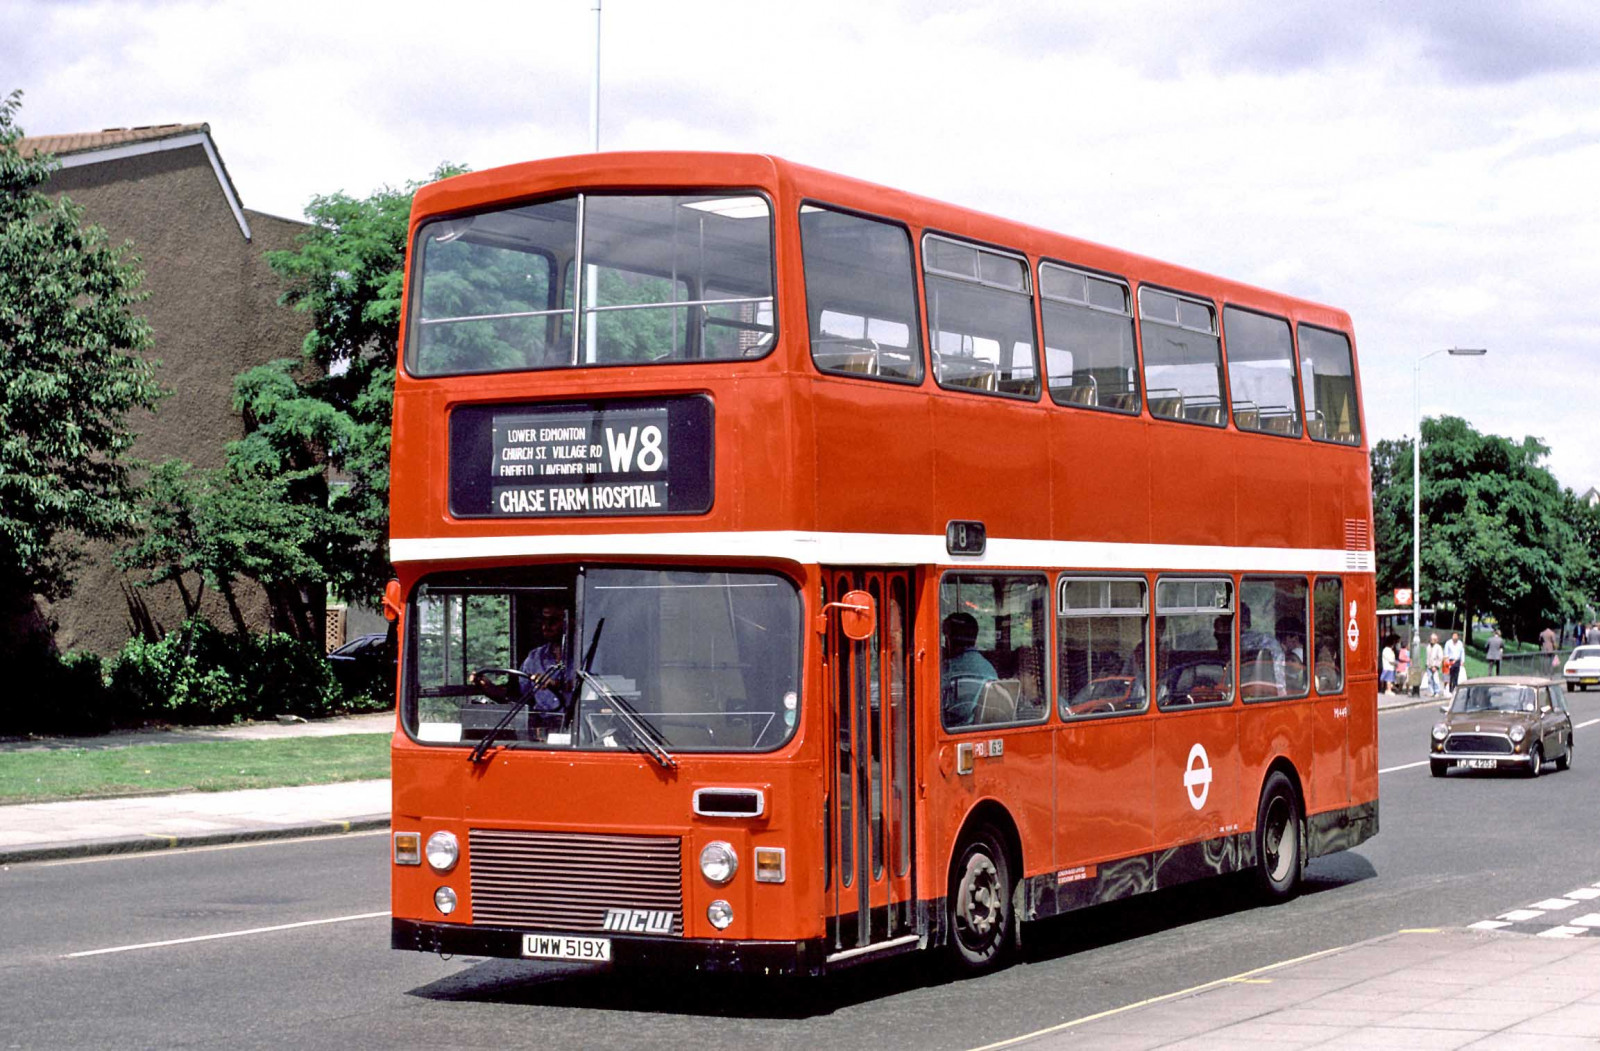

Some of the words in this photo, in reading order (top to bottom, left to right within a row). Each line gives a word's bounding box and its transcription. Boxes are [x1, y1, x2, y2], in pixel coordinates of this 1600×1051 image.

[507, 429, 537, 443] LOWER
[539, 427, 586, 442] EDMONTON
[502, 446, 533, 461] CHURCH
[552, 445, 587, 459] VILLAGE
[589, 444, 603, 458] RD
[605, 425, 664, 473] W8
[499, 489, 546, 513] CHASE
[549, 487, 590, 511] FARM
[592, 484, 662, 509] HOSPITAL
[991, 740, 1002, 754] 63
[528, 937, 561, 955] UWW
[566, 939, 605, 958] 519X
